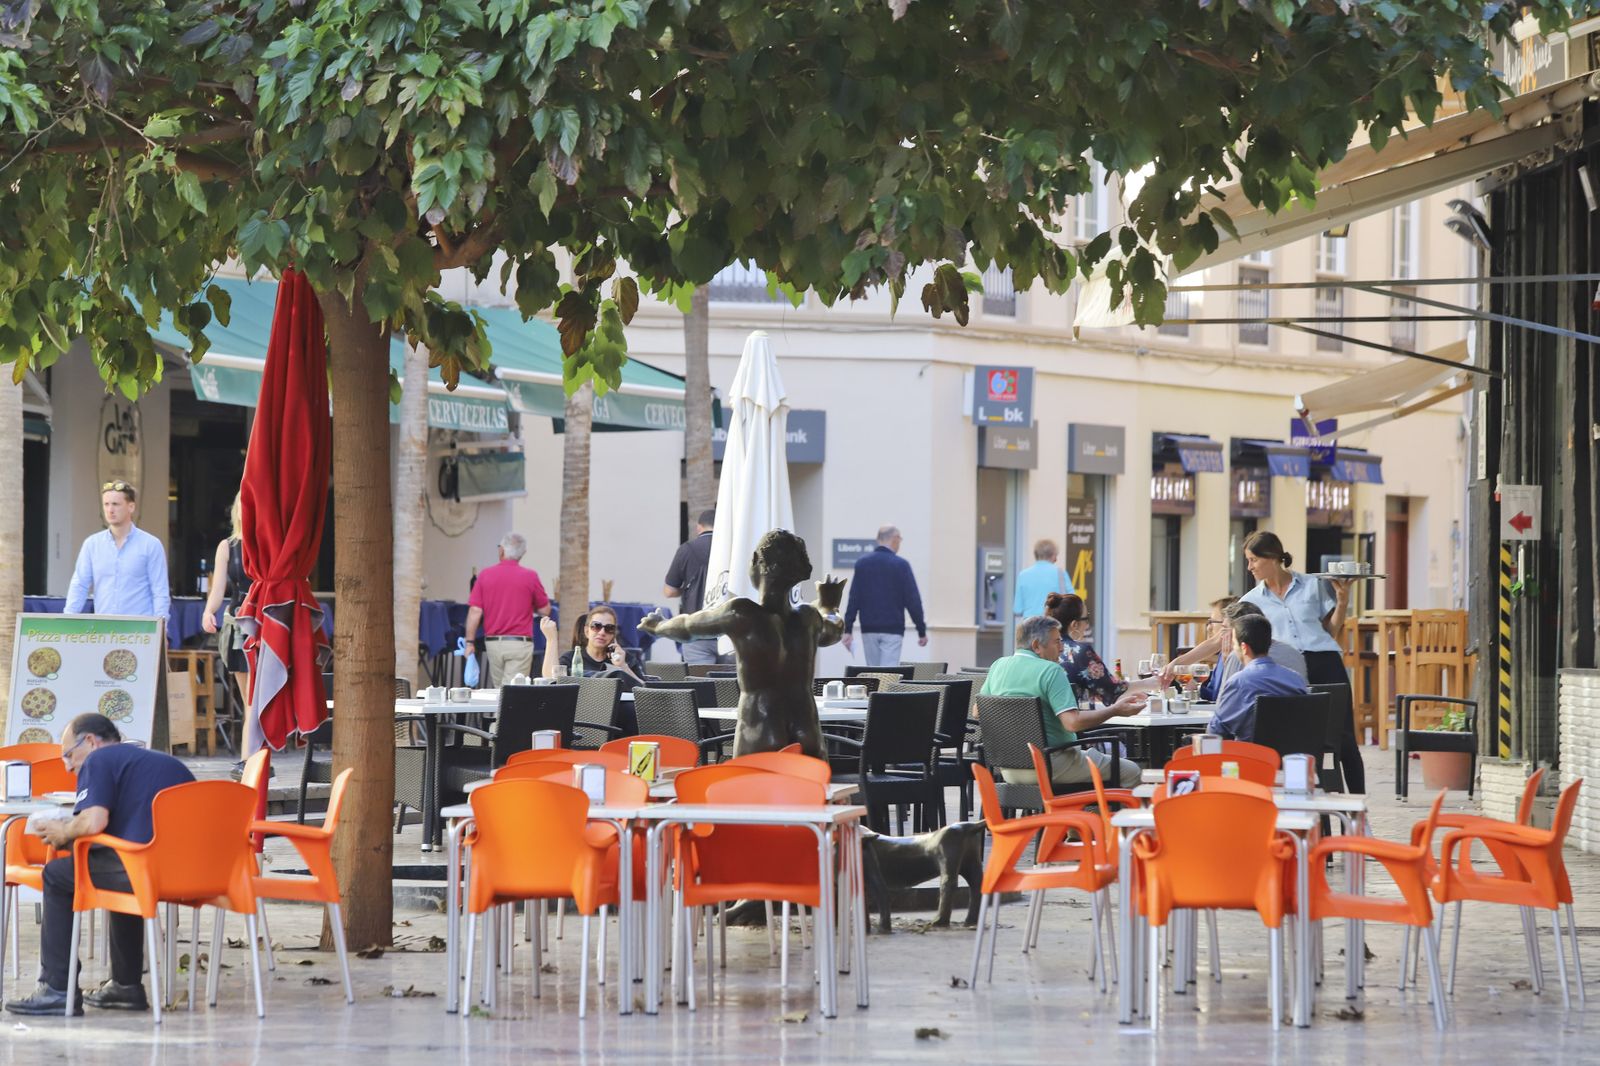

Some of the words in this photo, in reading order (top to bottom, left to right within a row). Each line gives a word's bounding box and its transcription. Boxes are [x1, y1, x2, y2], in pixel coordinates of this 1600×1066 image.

[428, 398, 508, 429] CERVECERIAS
[27, 628, 61, 643] Pizza
[64, 629, 106, 645] recién
[110, 630, 152, 646] hecha
